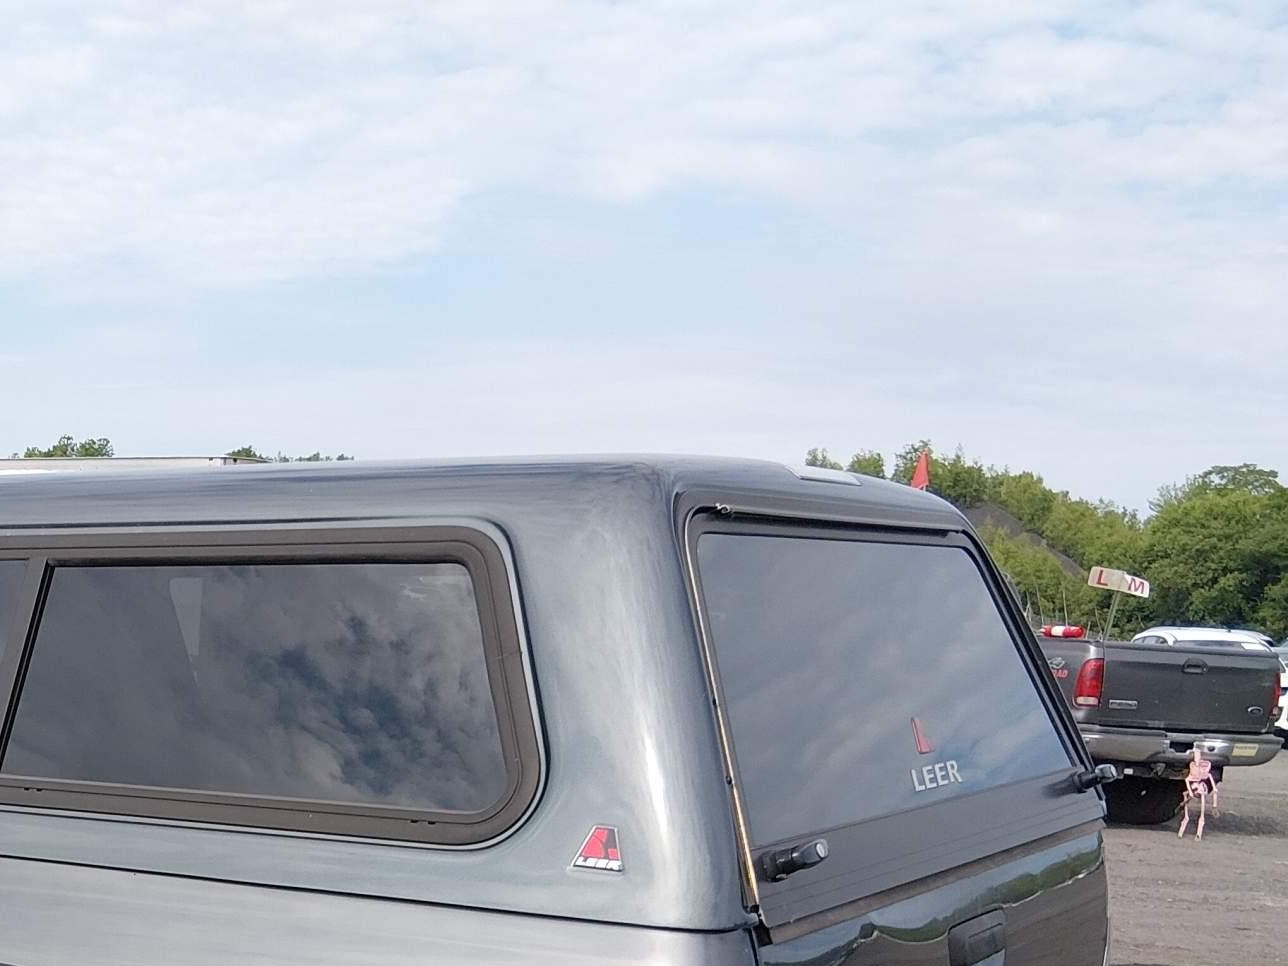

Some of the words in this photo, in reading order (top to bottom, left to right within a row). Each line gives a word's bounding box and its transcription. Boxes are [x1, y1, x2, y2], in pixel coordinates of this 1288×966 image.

[1096, 569, 1108, 586] L
[1128, 577, 1145, 594] M
[910, 759, 963, 792] LEER
[575, 857, 623, 871] LEER
